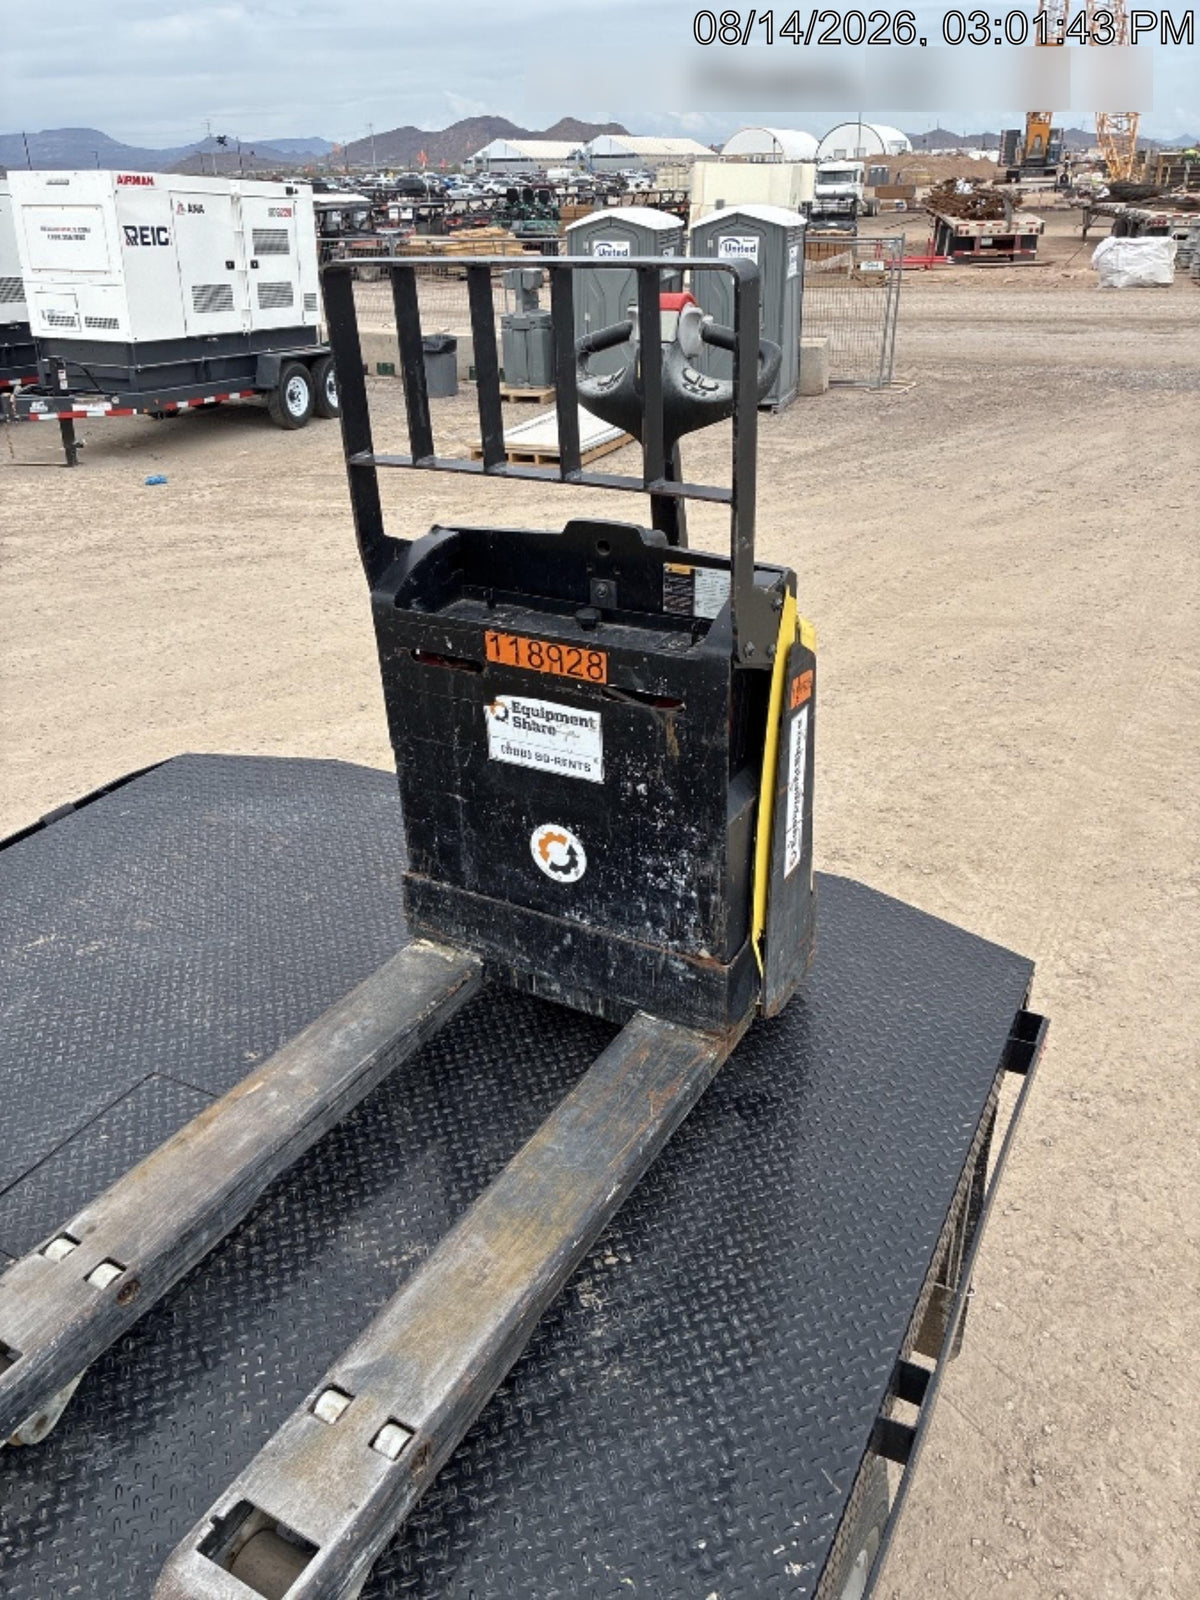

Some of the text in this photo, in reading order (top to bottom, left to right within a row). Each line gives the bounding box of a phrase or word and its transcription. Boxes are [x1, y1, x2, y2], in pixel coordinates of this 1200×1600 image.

[598, 248, 628, 256] United
[724, 243, 756, 253] United
[489, 634, 603, 680] 118928
[511, 700, 597, 731] Equipment
[512, 715, 557, 736] Share
